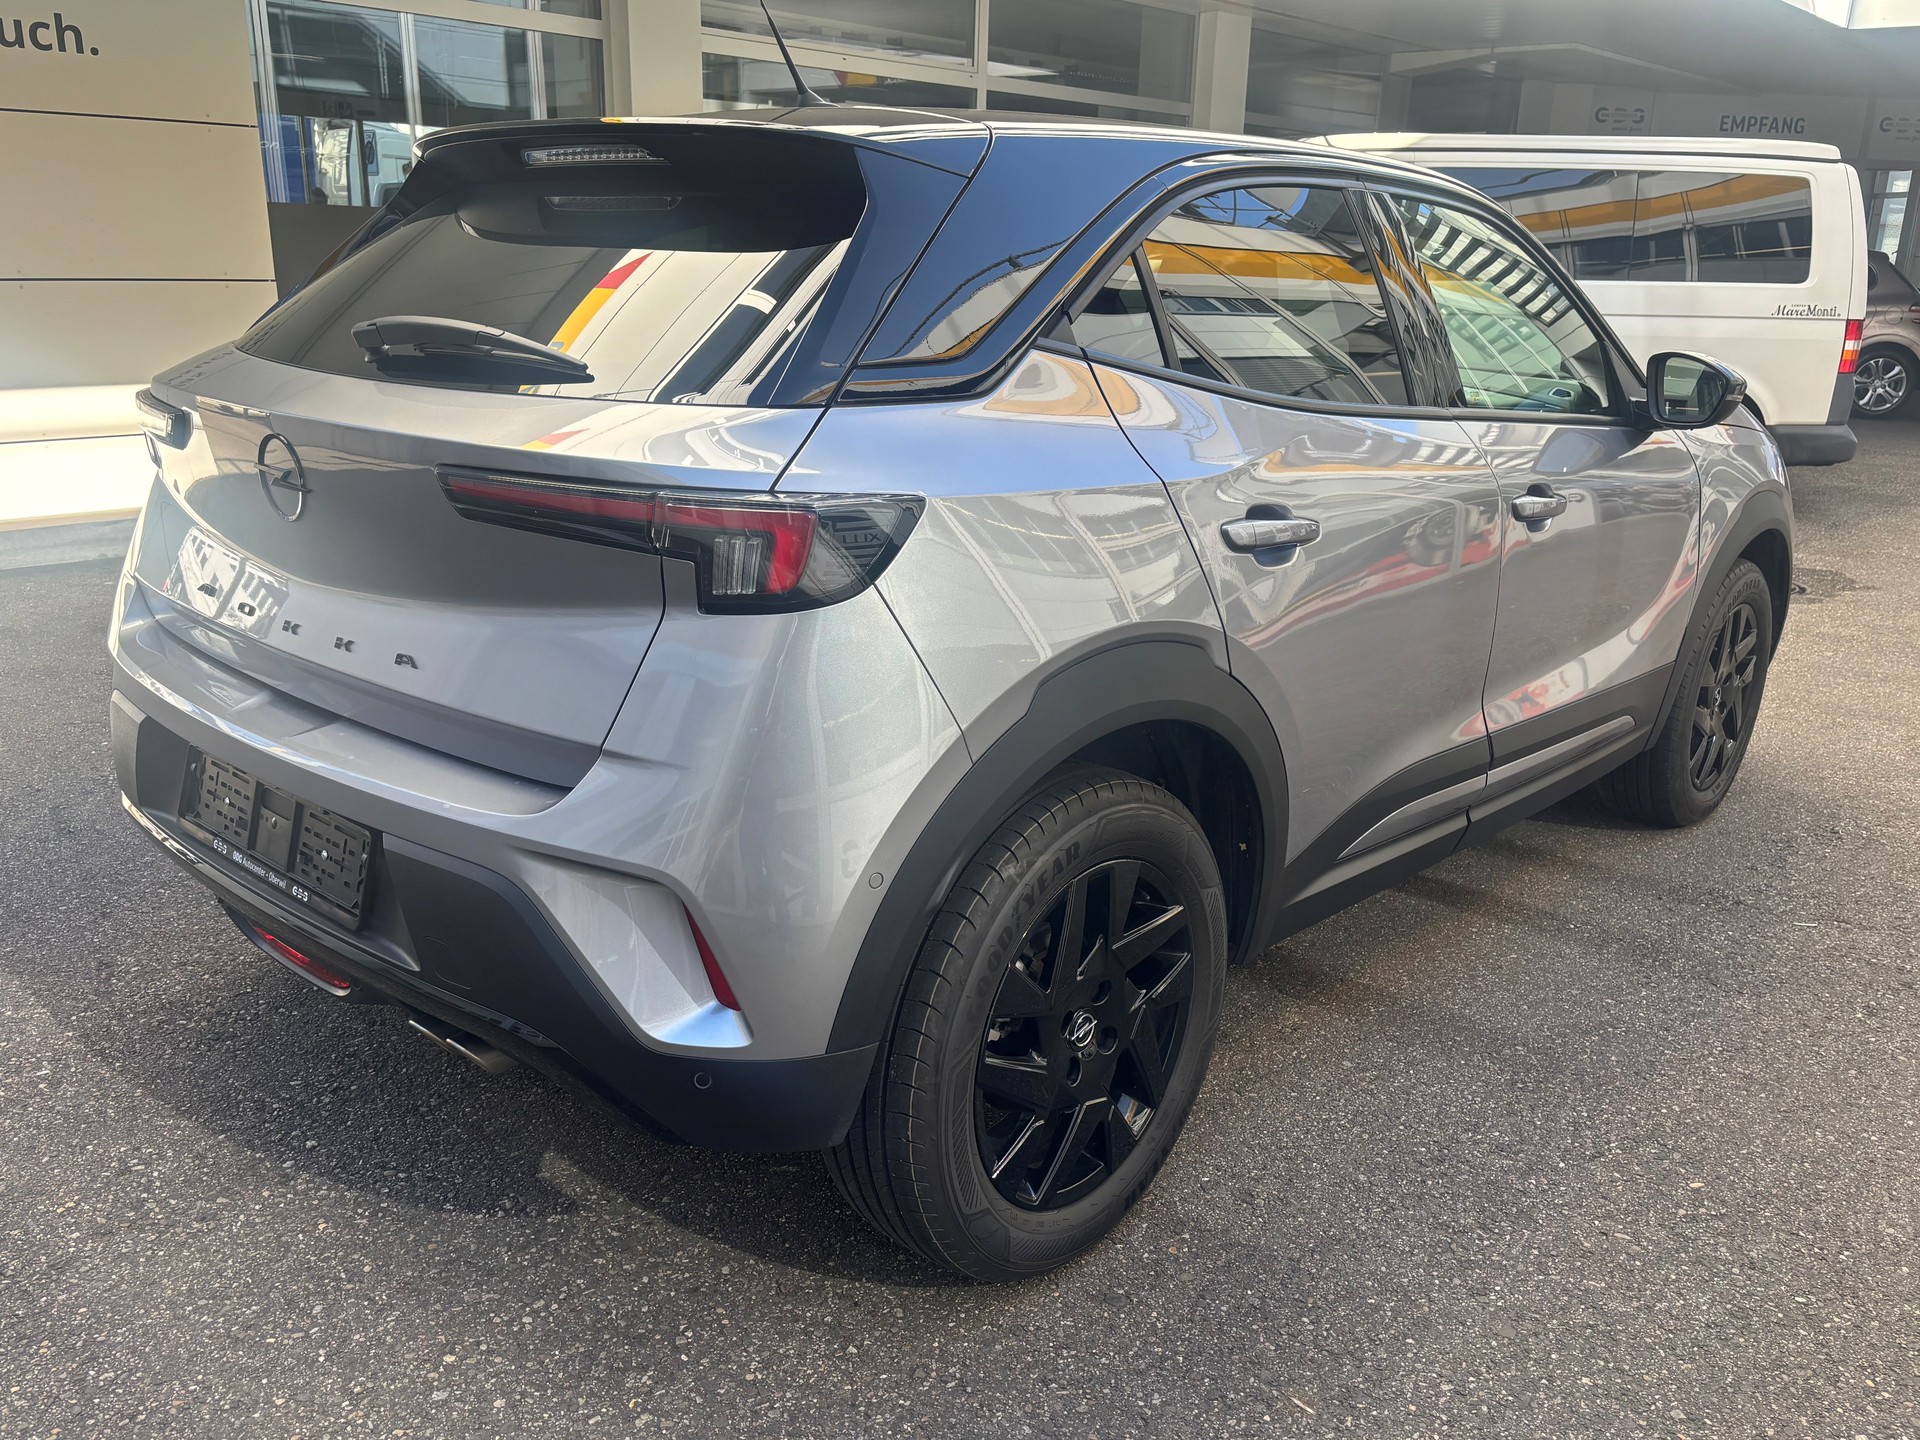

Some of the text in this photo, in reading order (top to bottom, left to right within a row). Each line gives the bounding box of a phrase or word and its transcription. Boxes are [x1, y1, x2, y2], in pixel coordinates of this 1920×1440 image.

[0, 12, 100, 56] uch.
[1719, 114, 1806, 134] EMPFANG
[197, 582, 419, 670] MOKKA
[268, 871, 287, 889] Oberwil
